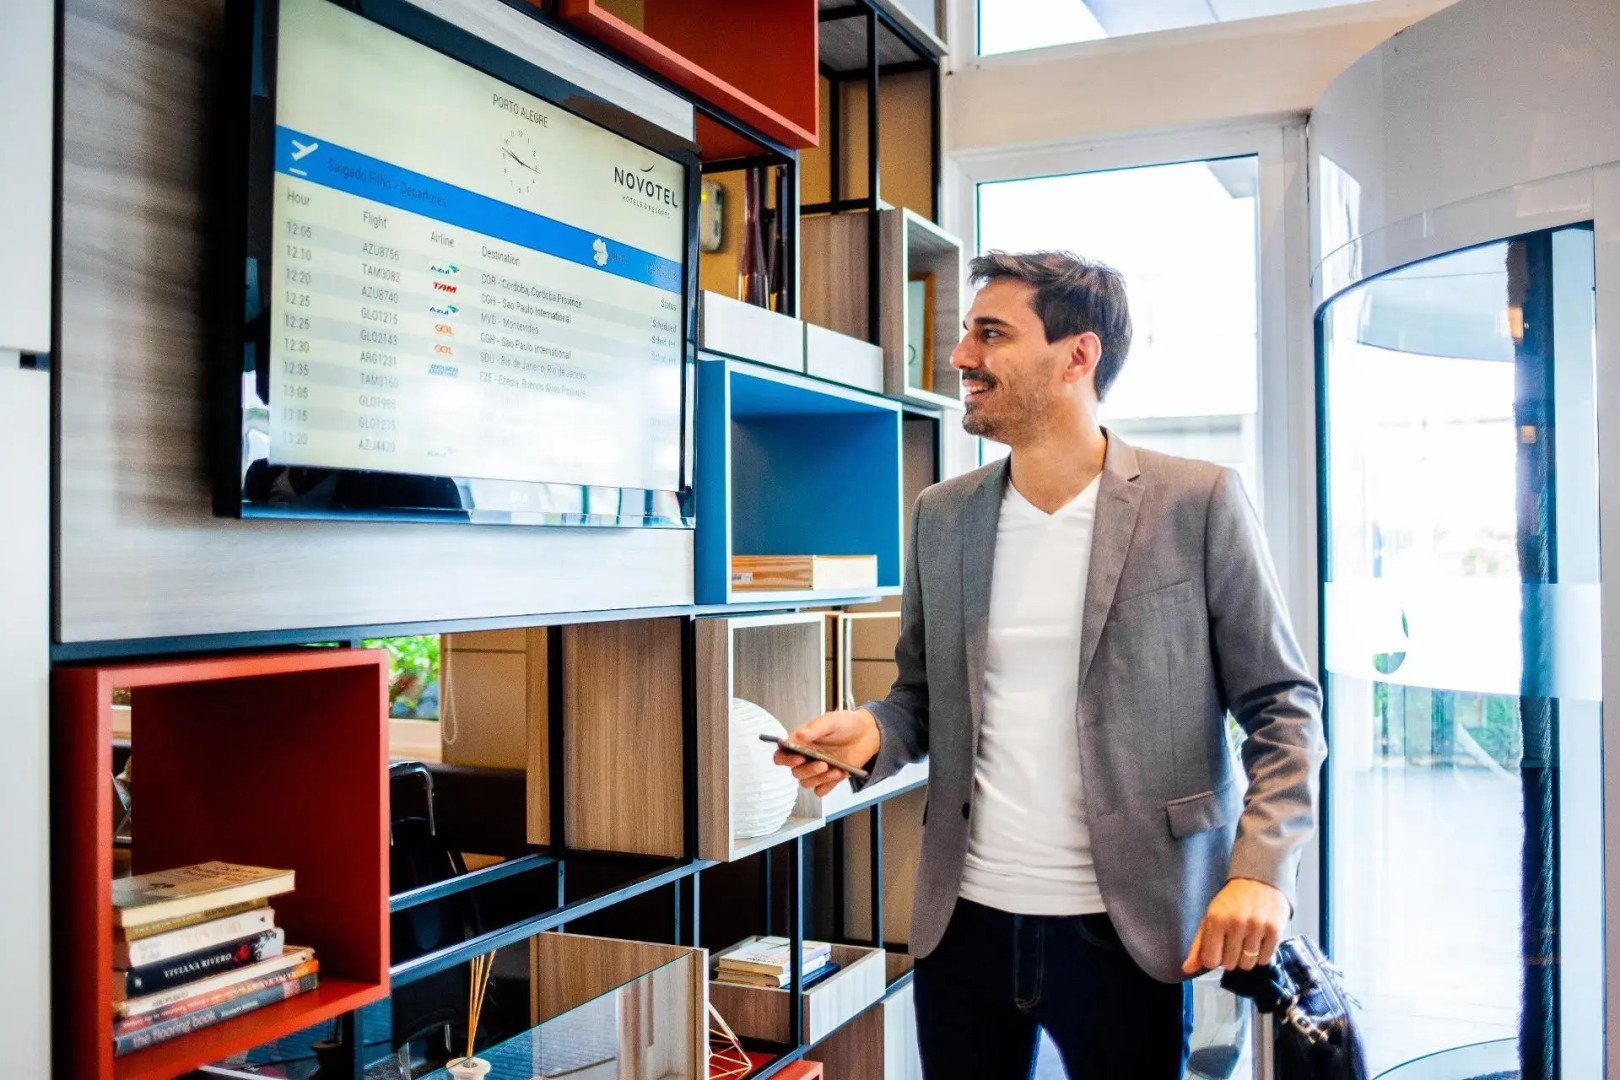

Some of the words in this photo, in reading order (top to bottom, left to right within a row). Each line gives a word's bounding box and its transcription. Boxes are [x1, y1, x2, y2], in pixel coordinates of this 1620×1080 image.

[493, 93, 519, 114] PORTO
[520, 107, 548, 128] ALEGRE
[327, 157, 367, 183] Salgado
[369, 168, 391, 190] Filho
[400, 181, 447, 208] Departures
[614, 166, 678, 208] NOVOTEL
[287, 188, 311, 207] Hour
[362, 210, 387, 230] Flight
[286, 222, 312, 239] 12:05
[430, 231, 454, 248] Airline
[286, 244, 312, 262] 12:10
[362, 242, 400, 262] AZU8756
[482, 245, 520, 266] Destination
[286, 268, 312, 286] 12:20
[362, 264, 400, 283] TAM3082
[361, 285, 399, 304] AZU8740
[432, 281, 458, 294] TAM
[481, 274, 496, 286] COR
[558, 294, 582, 308] Province
[285, 291, 311, 308] 12:25
[481, 293, 496, 306] CGH
[502, 298, 514, 310] Sao
[516, 302, 534, 314] Paulo
[534, 306, 572, 324] International
[284, 314, 310, 330] 12:25
[480, 312, 496, 325] MVD
[503, 318, 539, 334] Montevideo
[284, 338, 310, 354] 12:30
[480, 332, 496, 345] CGH
[502, 336, 514, 348] Sao
[515, 340, 533, 352] Paulo
[534, 344, 572, 360] International
[360, 352, 397, 368] ARG1231
[480, 352, 495, 364] SDU
[163, 960, 200, 978] VIVIANA
[200, 952, 232, 968] RIVERO
